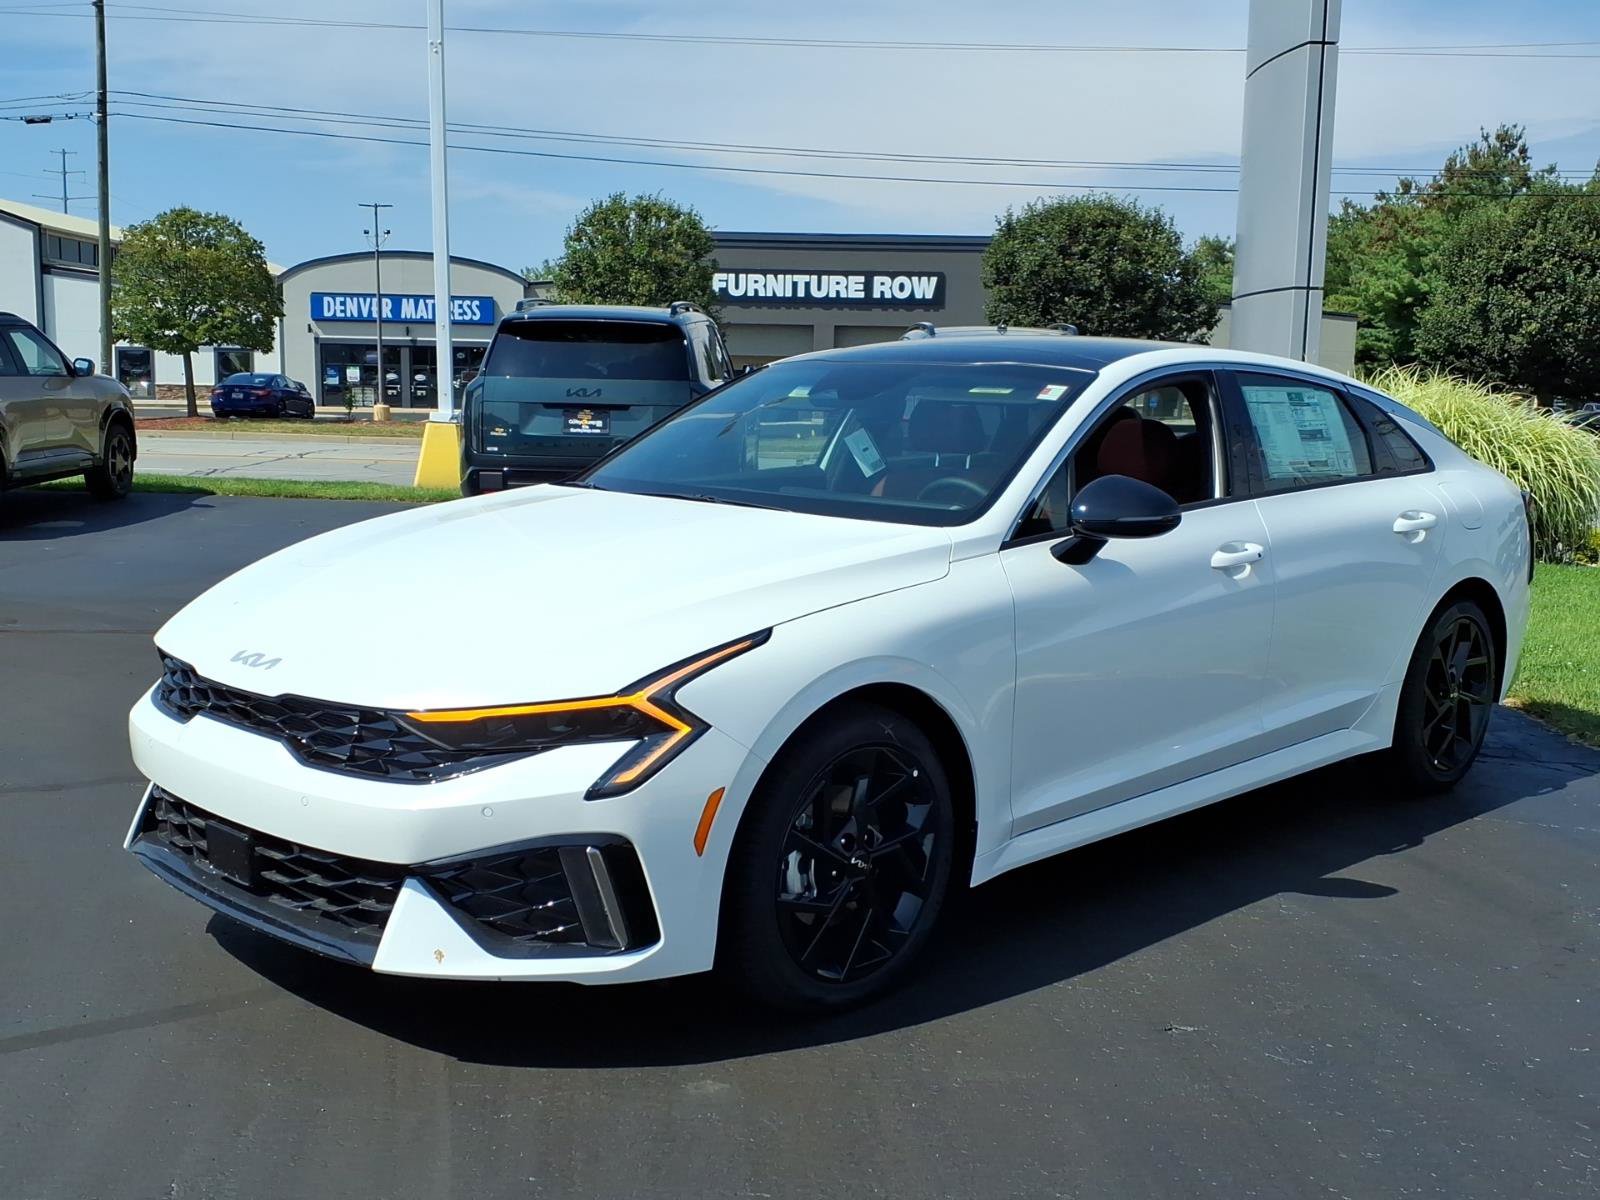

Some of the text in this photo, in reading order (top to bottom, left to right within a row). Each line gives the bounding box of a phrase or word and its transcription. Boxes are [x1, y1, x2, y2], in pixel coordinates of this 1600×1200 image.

[712, 273, 938, 299] FURNITURE ROW
[322, 296, 481, 321] DENVER MATESS
[566, 388, 602, 397] KIA
[229, 649, 283, 671] KIA
